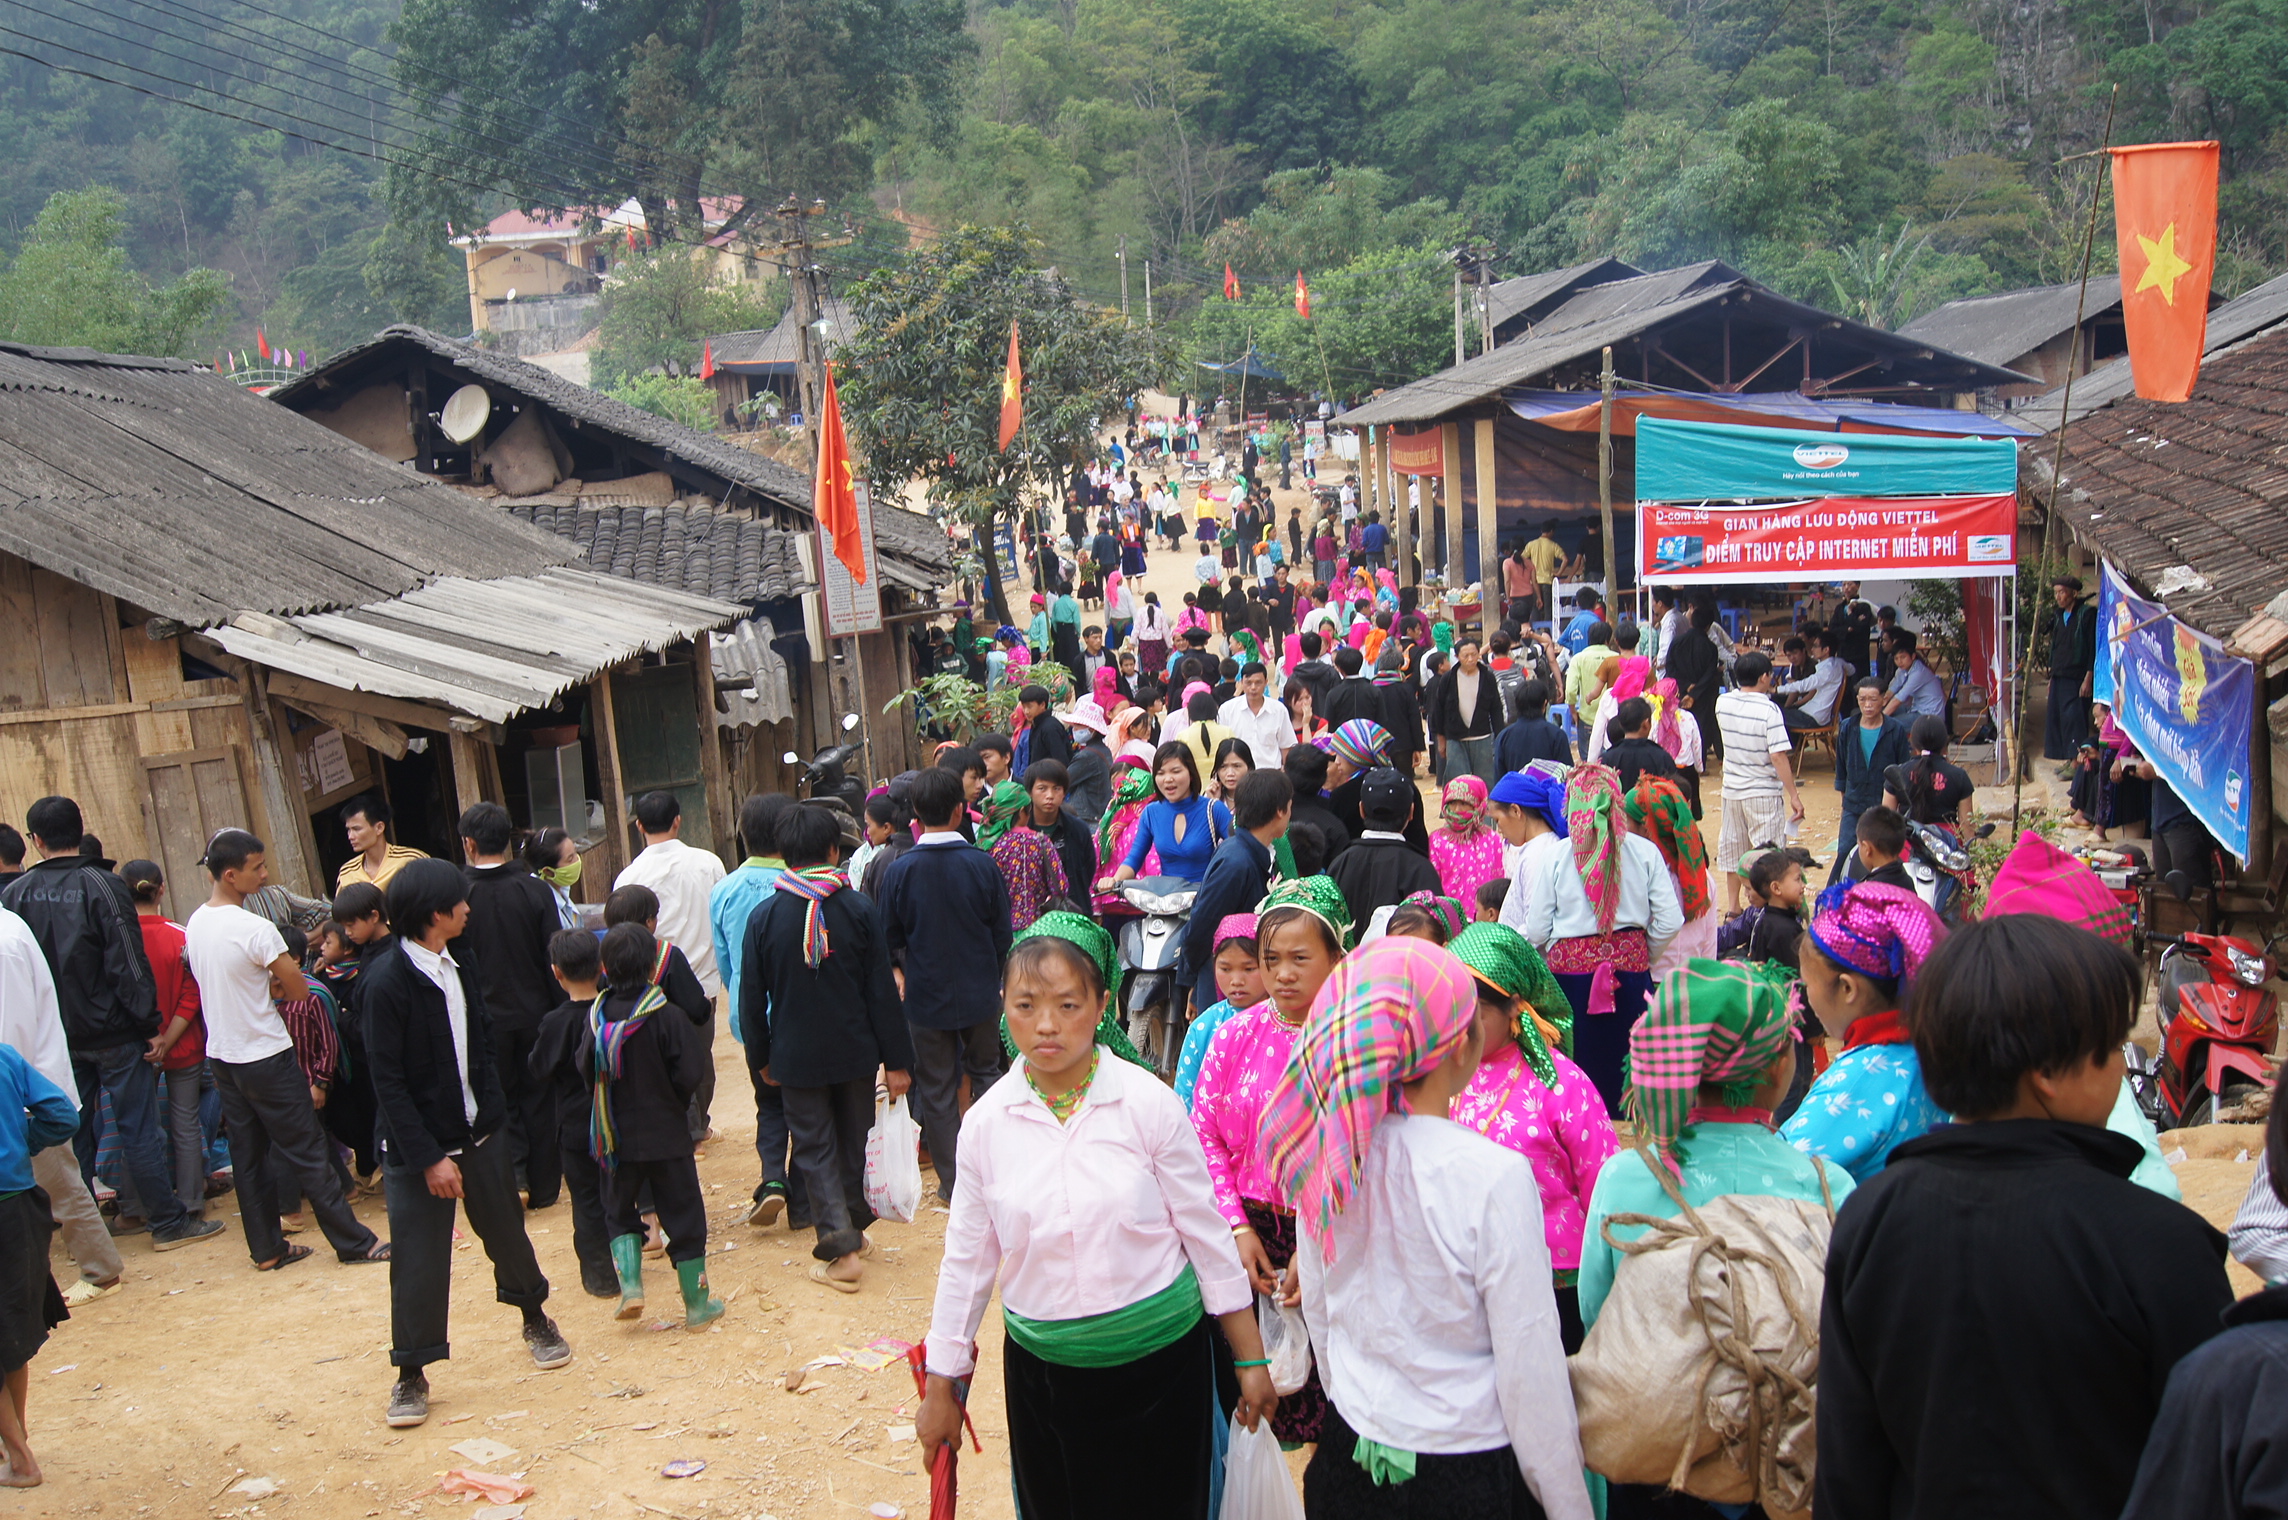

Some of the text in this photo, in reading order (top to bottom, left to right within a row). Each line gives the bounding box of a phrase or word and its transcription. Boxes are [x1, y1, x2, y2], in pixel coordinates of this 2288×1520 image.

[1655, 510, 1709, 521] D-com 3G
[1723, 510, 1939, 531] GIAN HÀNG LƯU ĐỘNG VIETTEL
[1706, 527, 1958, 567] ĐIỂM TRUY CẬP INTERNET MIỄN PHÍ
